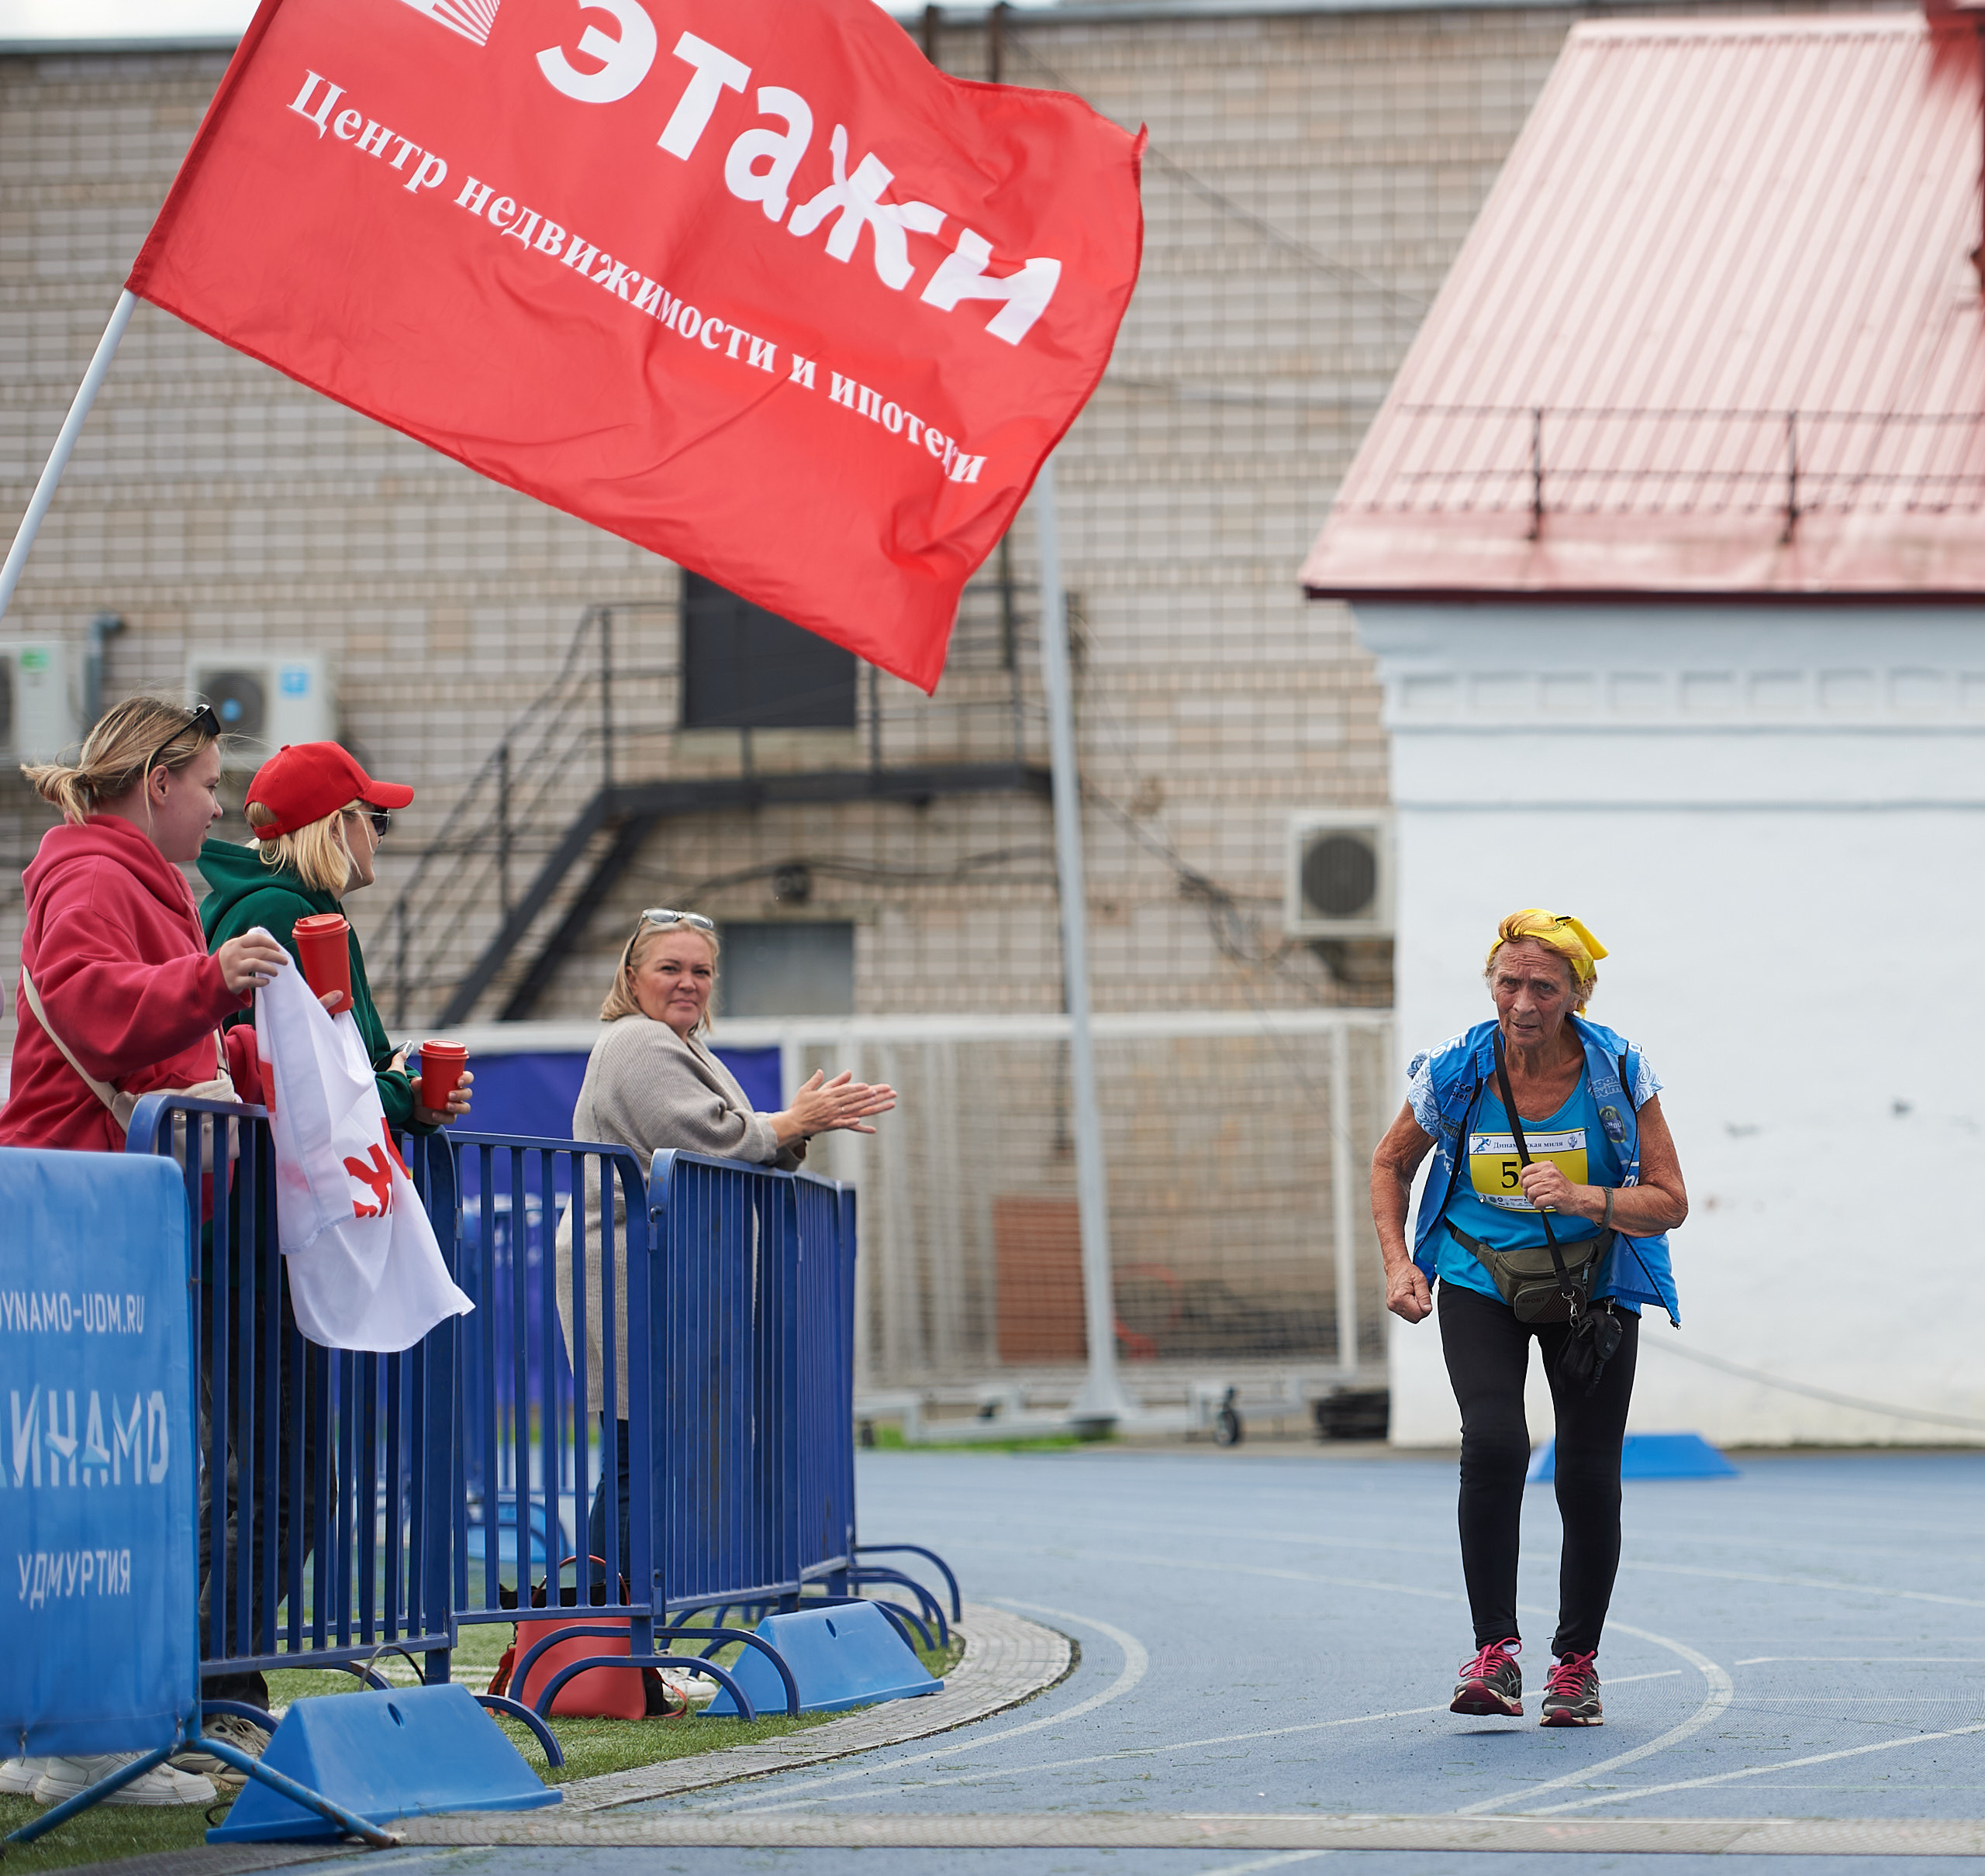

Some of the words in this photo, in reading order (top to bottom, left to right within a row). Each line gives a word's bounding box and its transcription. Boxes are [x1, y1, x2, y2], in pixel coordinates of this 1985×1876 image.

[287, 69, 447, 194] Центр
[454, 176, 778, 374] недвижимости
[789, 353, 816, 389] и
[829, 371, 987, 483] ипотеки
[0, 1290, 146, 1333] YNAMO-UDM.RU
[0, 1384, 169, 1488] ИНАМО
[18, 1549, 130, 1610] УДМУРТИЯ
